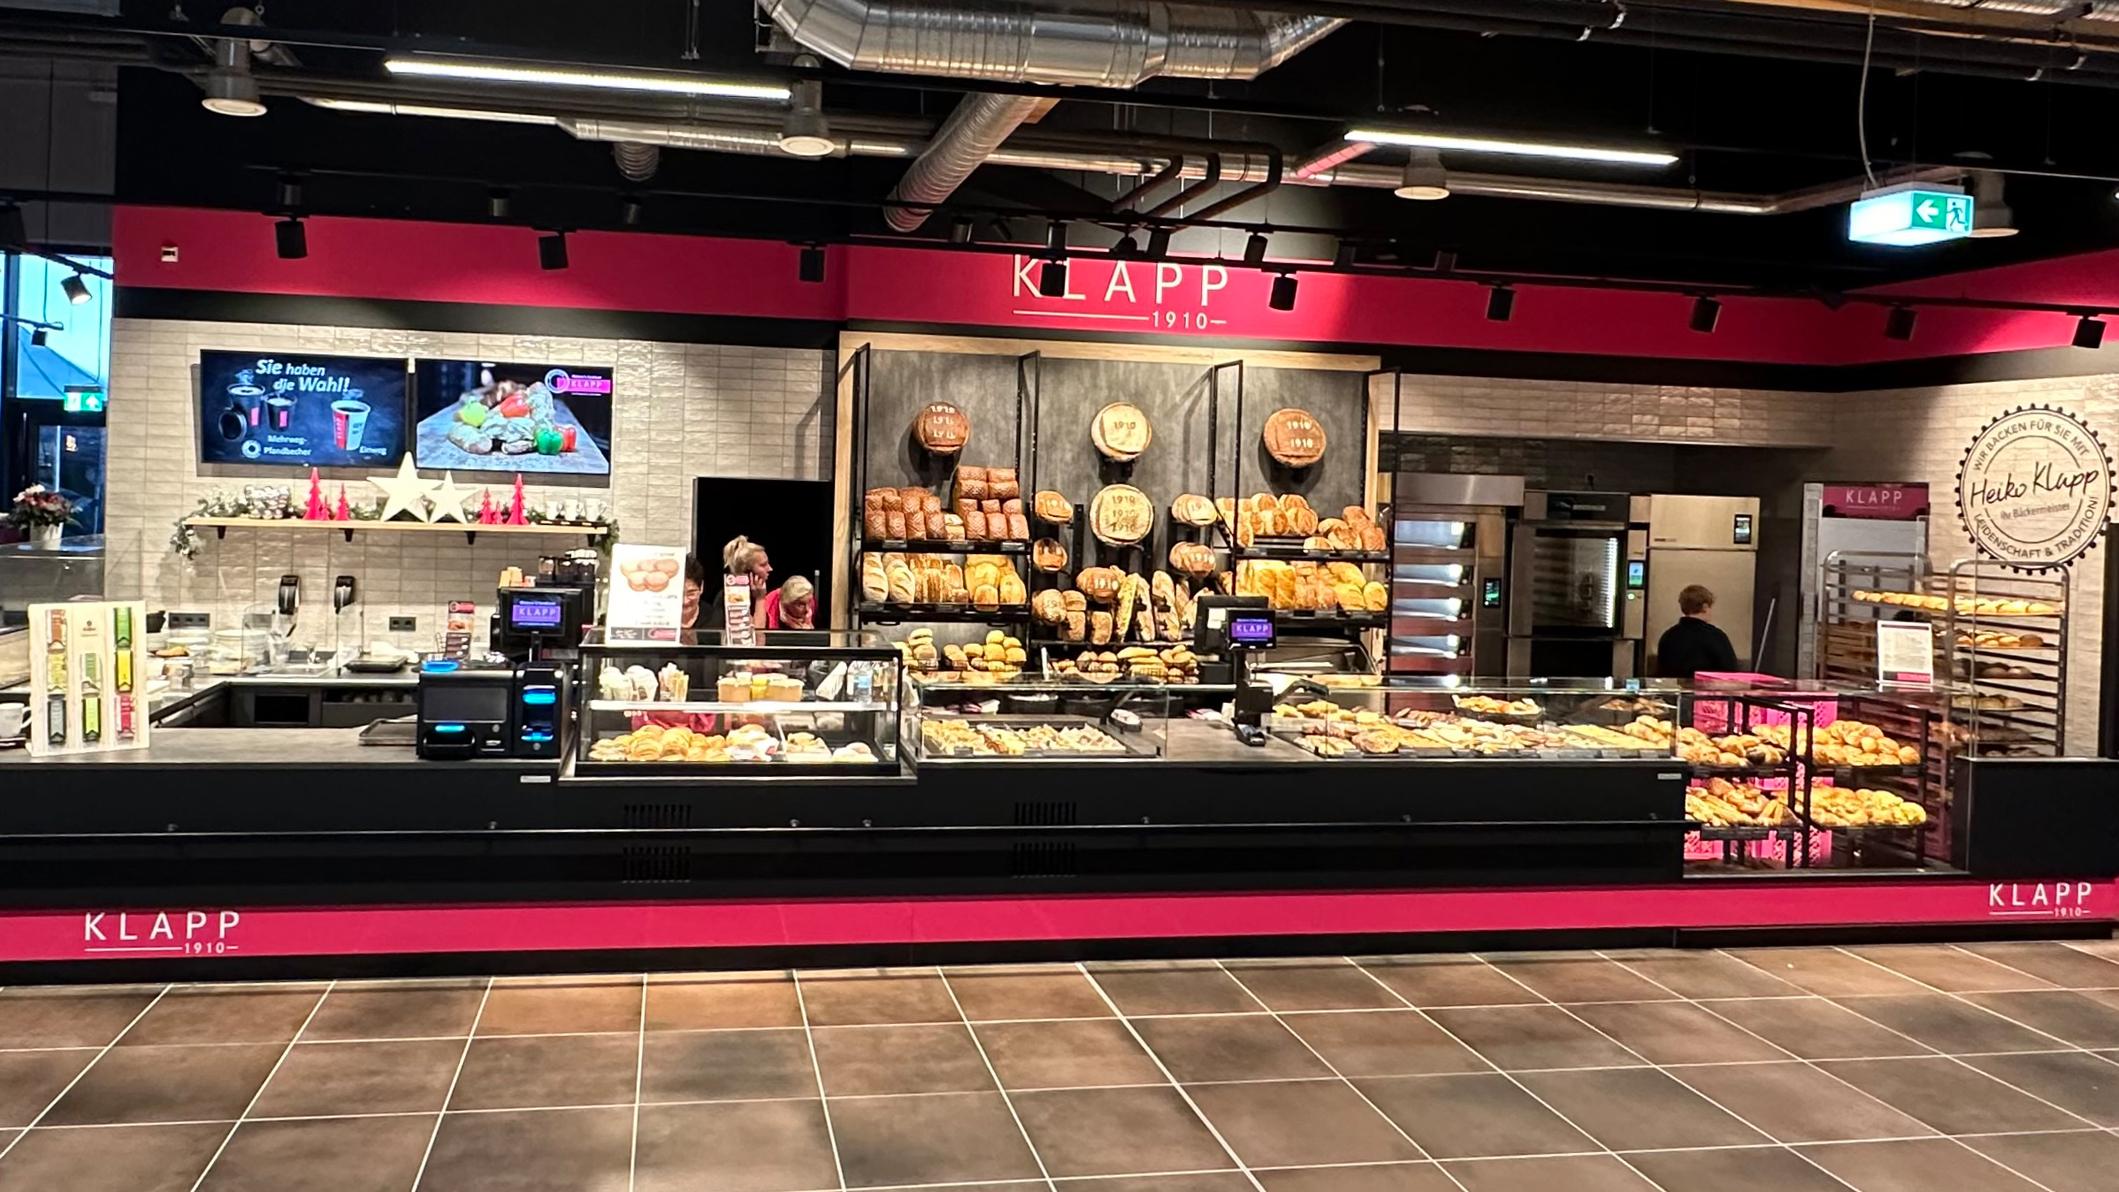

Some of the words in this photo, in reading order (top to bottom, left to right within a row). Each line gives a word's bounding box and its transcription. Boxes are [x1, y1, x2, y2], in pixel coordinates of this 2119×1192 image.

[1012, 254, 1229, 307] KLAPP
[1152, 310, 1208, 329] 1910
[255, 358, 283, 375] Sie
[285, 362, 326, 376] haben
[298, 376, 350, 392] Wahl!
[570, 380, 602, 388] KLAPP
[1973, 449, 1989, 471] WIR
[1986, 422, 2027, 452] BACKEN
[2030, 419, 2053, 433] FÜR
[2055, 424, 2071, 441] SIE
[2070, 436, 2090, 457] MIT
[1970, 473, 2028, 508] Heiko
[2032, 461, 2100, 498] Klapp
[1845, 489, 1902, 504] KLAPP
[1974, 513, 2041, 558] LEIDENSCHAFT
[519, 607, 556, 616] KLAPP
[1236, 624, 1269, 633] KLAPP
[1988, 881, 2092, 907] KLAPP
[84, 910, 240, 941] KLAPP
[184, 941, 225, 954] 1910
